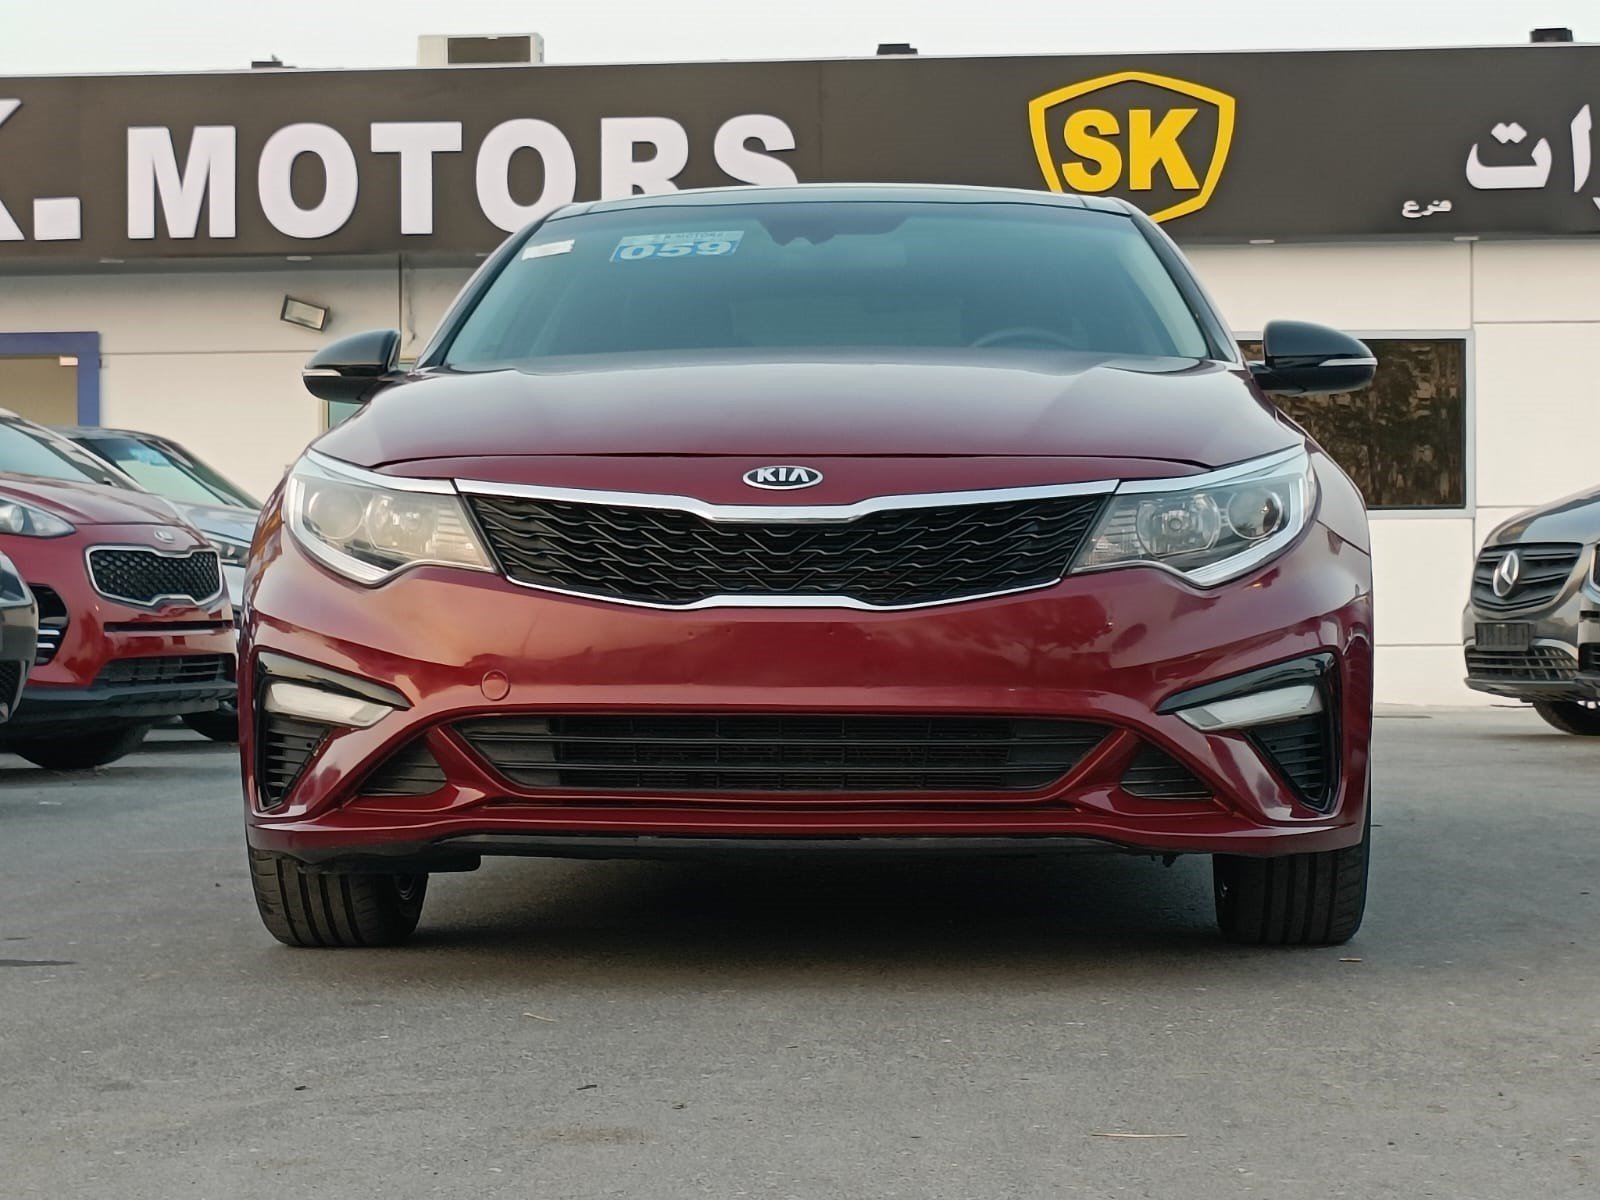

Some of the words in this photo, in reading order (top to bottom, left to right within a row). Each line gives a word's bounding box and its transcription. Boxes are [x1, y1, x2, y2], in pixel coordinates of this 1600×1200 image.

[1062, 108, 1200, 192] SK
[127, 114, 798, 239] MOTORS
[1402, 200, 1452, 218] فرع
[620, 241, 731, 260] 059
[757, 467, 810, 483] KIA
